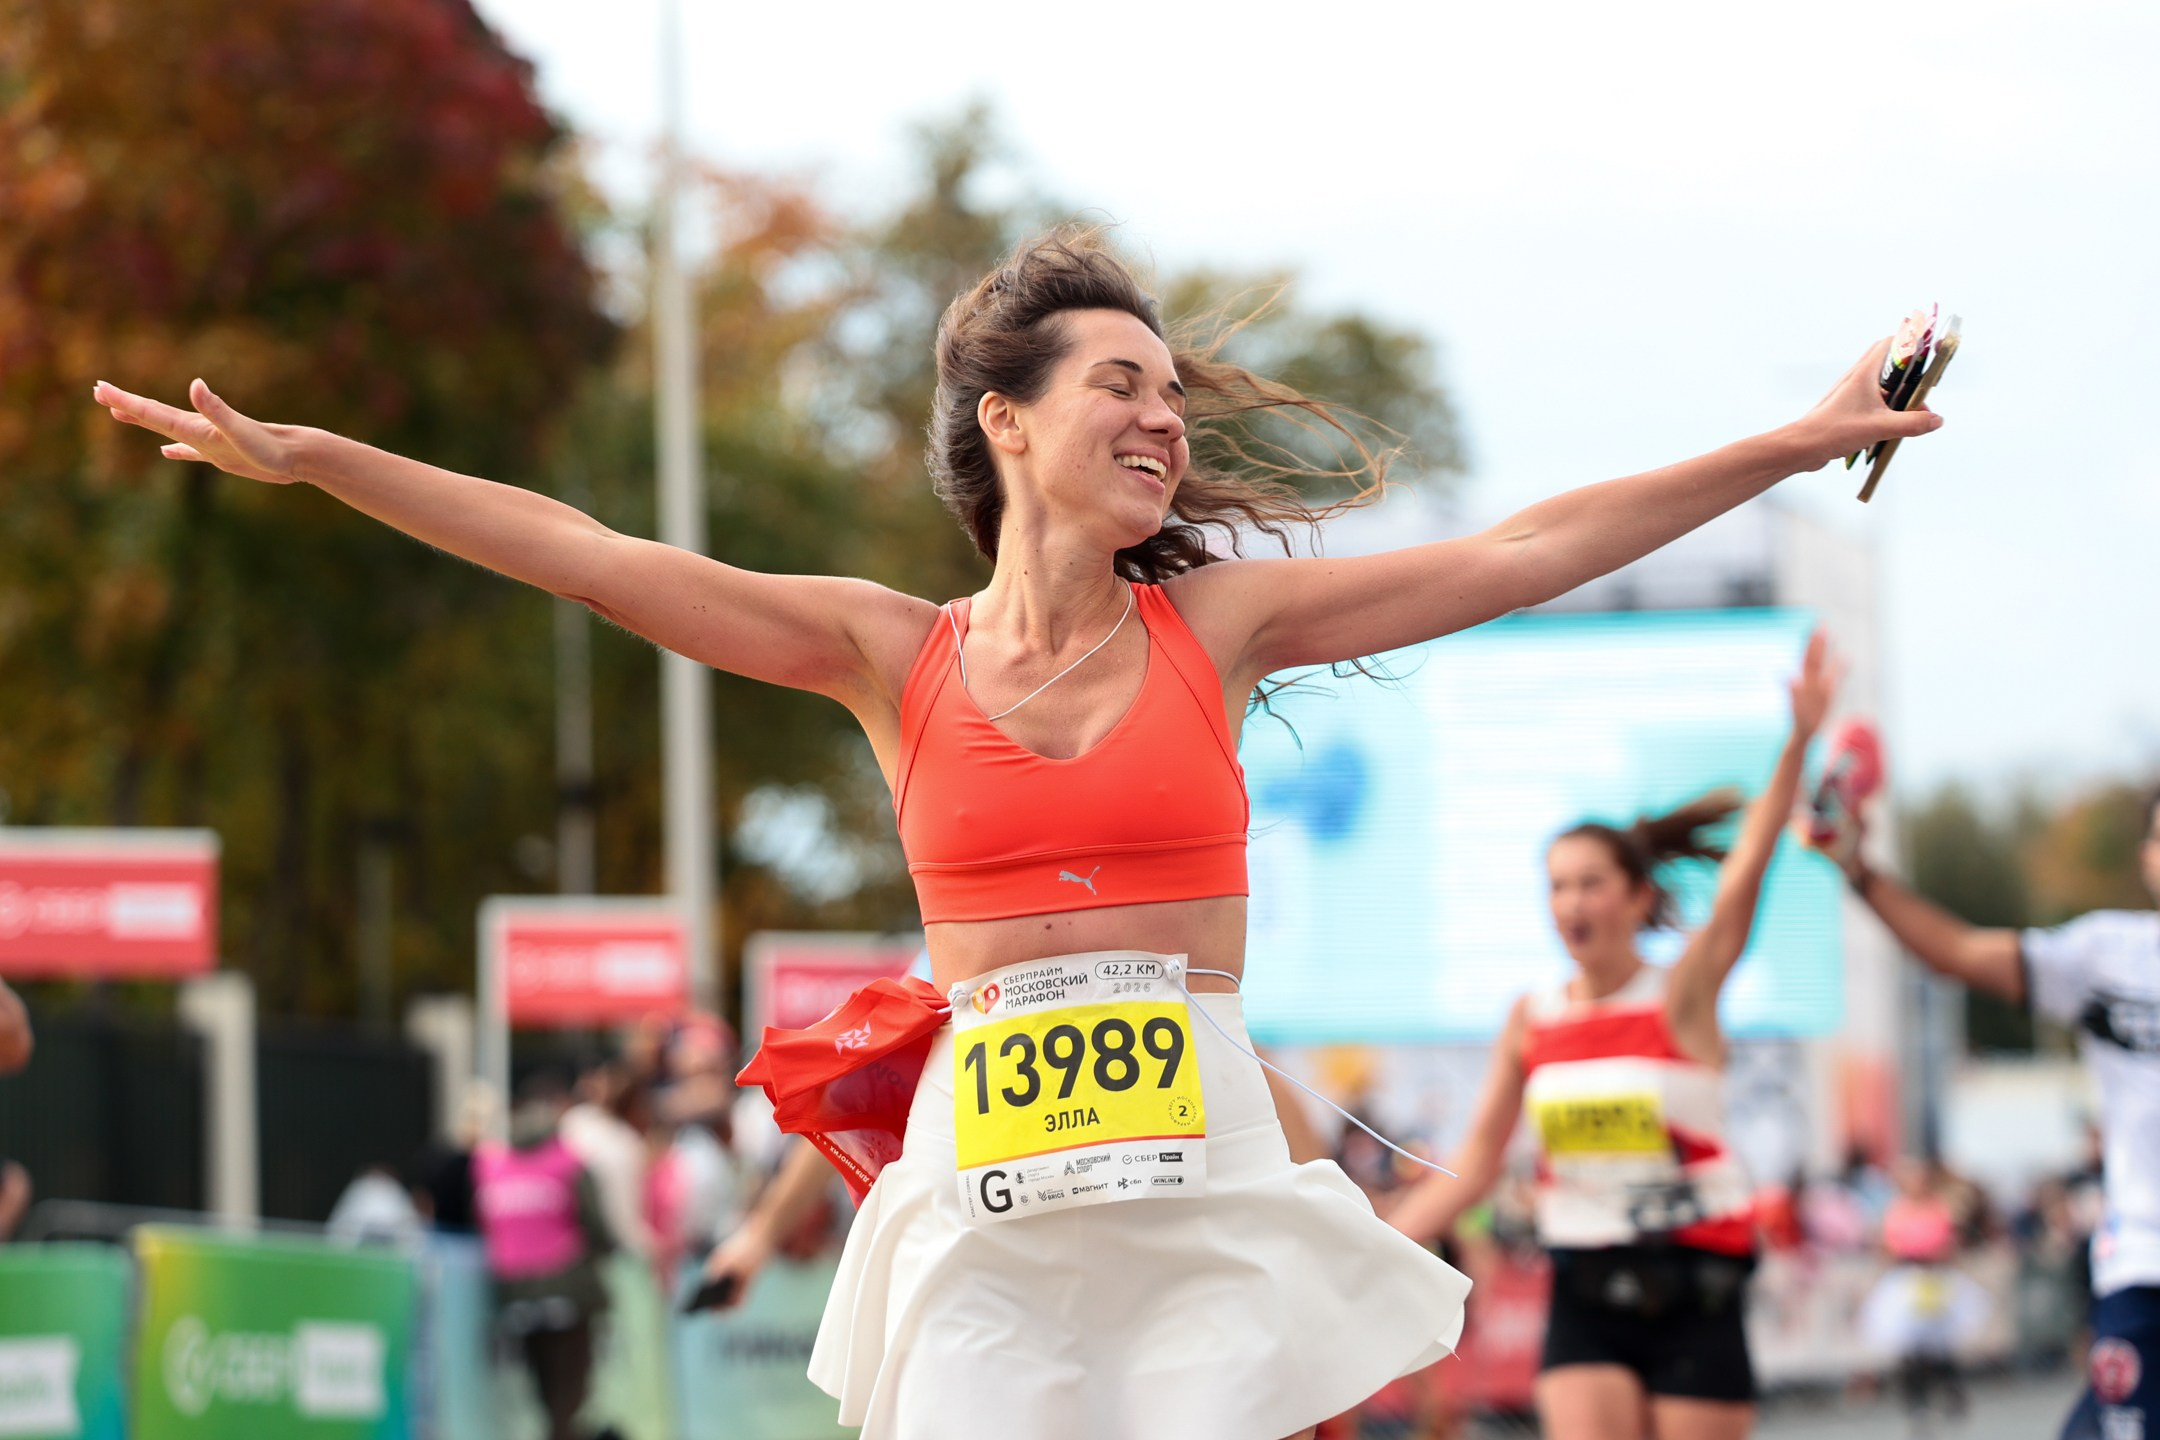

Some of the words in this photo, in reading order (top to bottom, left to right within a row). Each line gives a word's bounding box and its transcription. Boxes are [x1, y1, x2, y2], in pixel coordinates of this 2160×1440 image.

[1003, 966, 1063, 986] СБЕРПРАЙМ
[1103, 963, 1132, 976] 42,2
[1136, 963, 1156, 975] КМ
[1004, 972, 1088, 998] МОСКОВСКИЙ
[1113, 982, 1151, 994] 2026
[1005, 989, 1066, 1010] МАРАФОН
[964, 1016, 1185, 1115] 13989
[1044, 1107, 1101, 1133] ЭЛЛА
[1178, 1104, 1188, 1117] 2
[829, 1145, 856, 1171] МНОГИХ
[1134, 1154, 1158, 1162] СБЕР
[980, 1169, 1014, 1214] G
